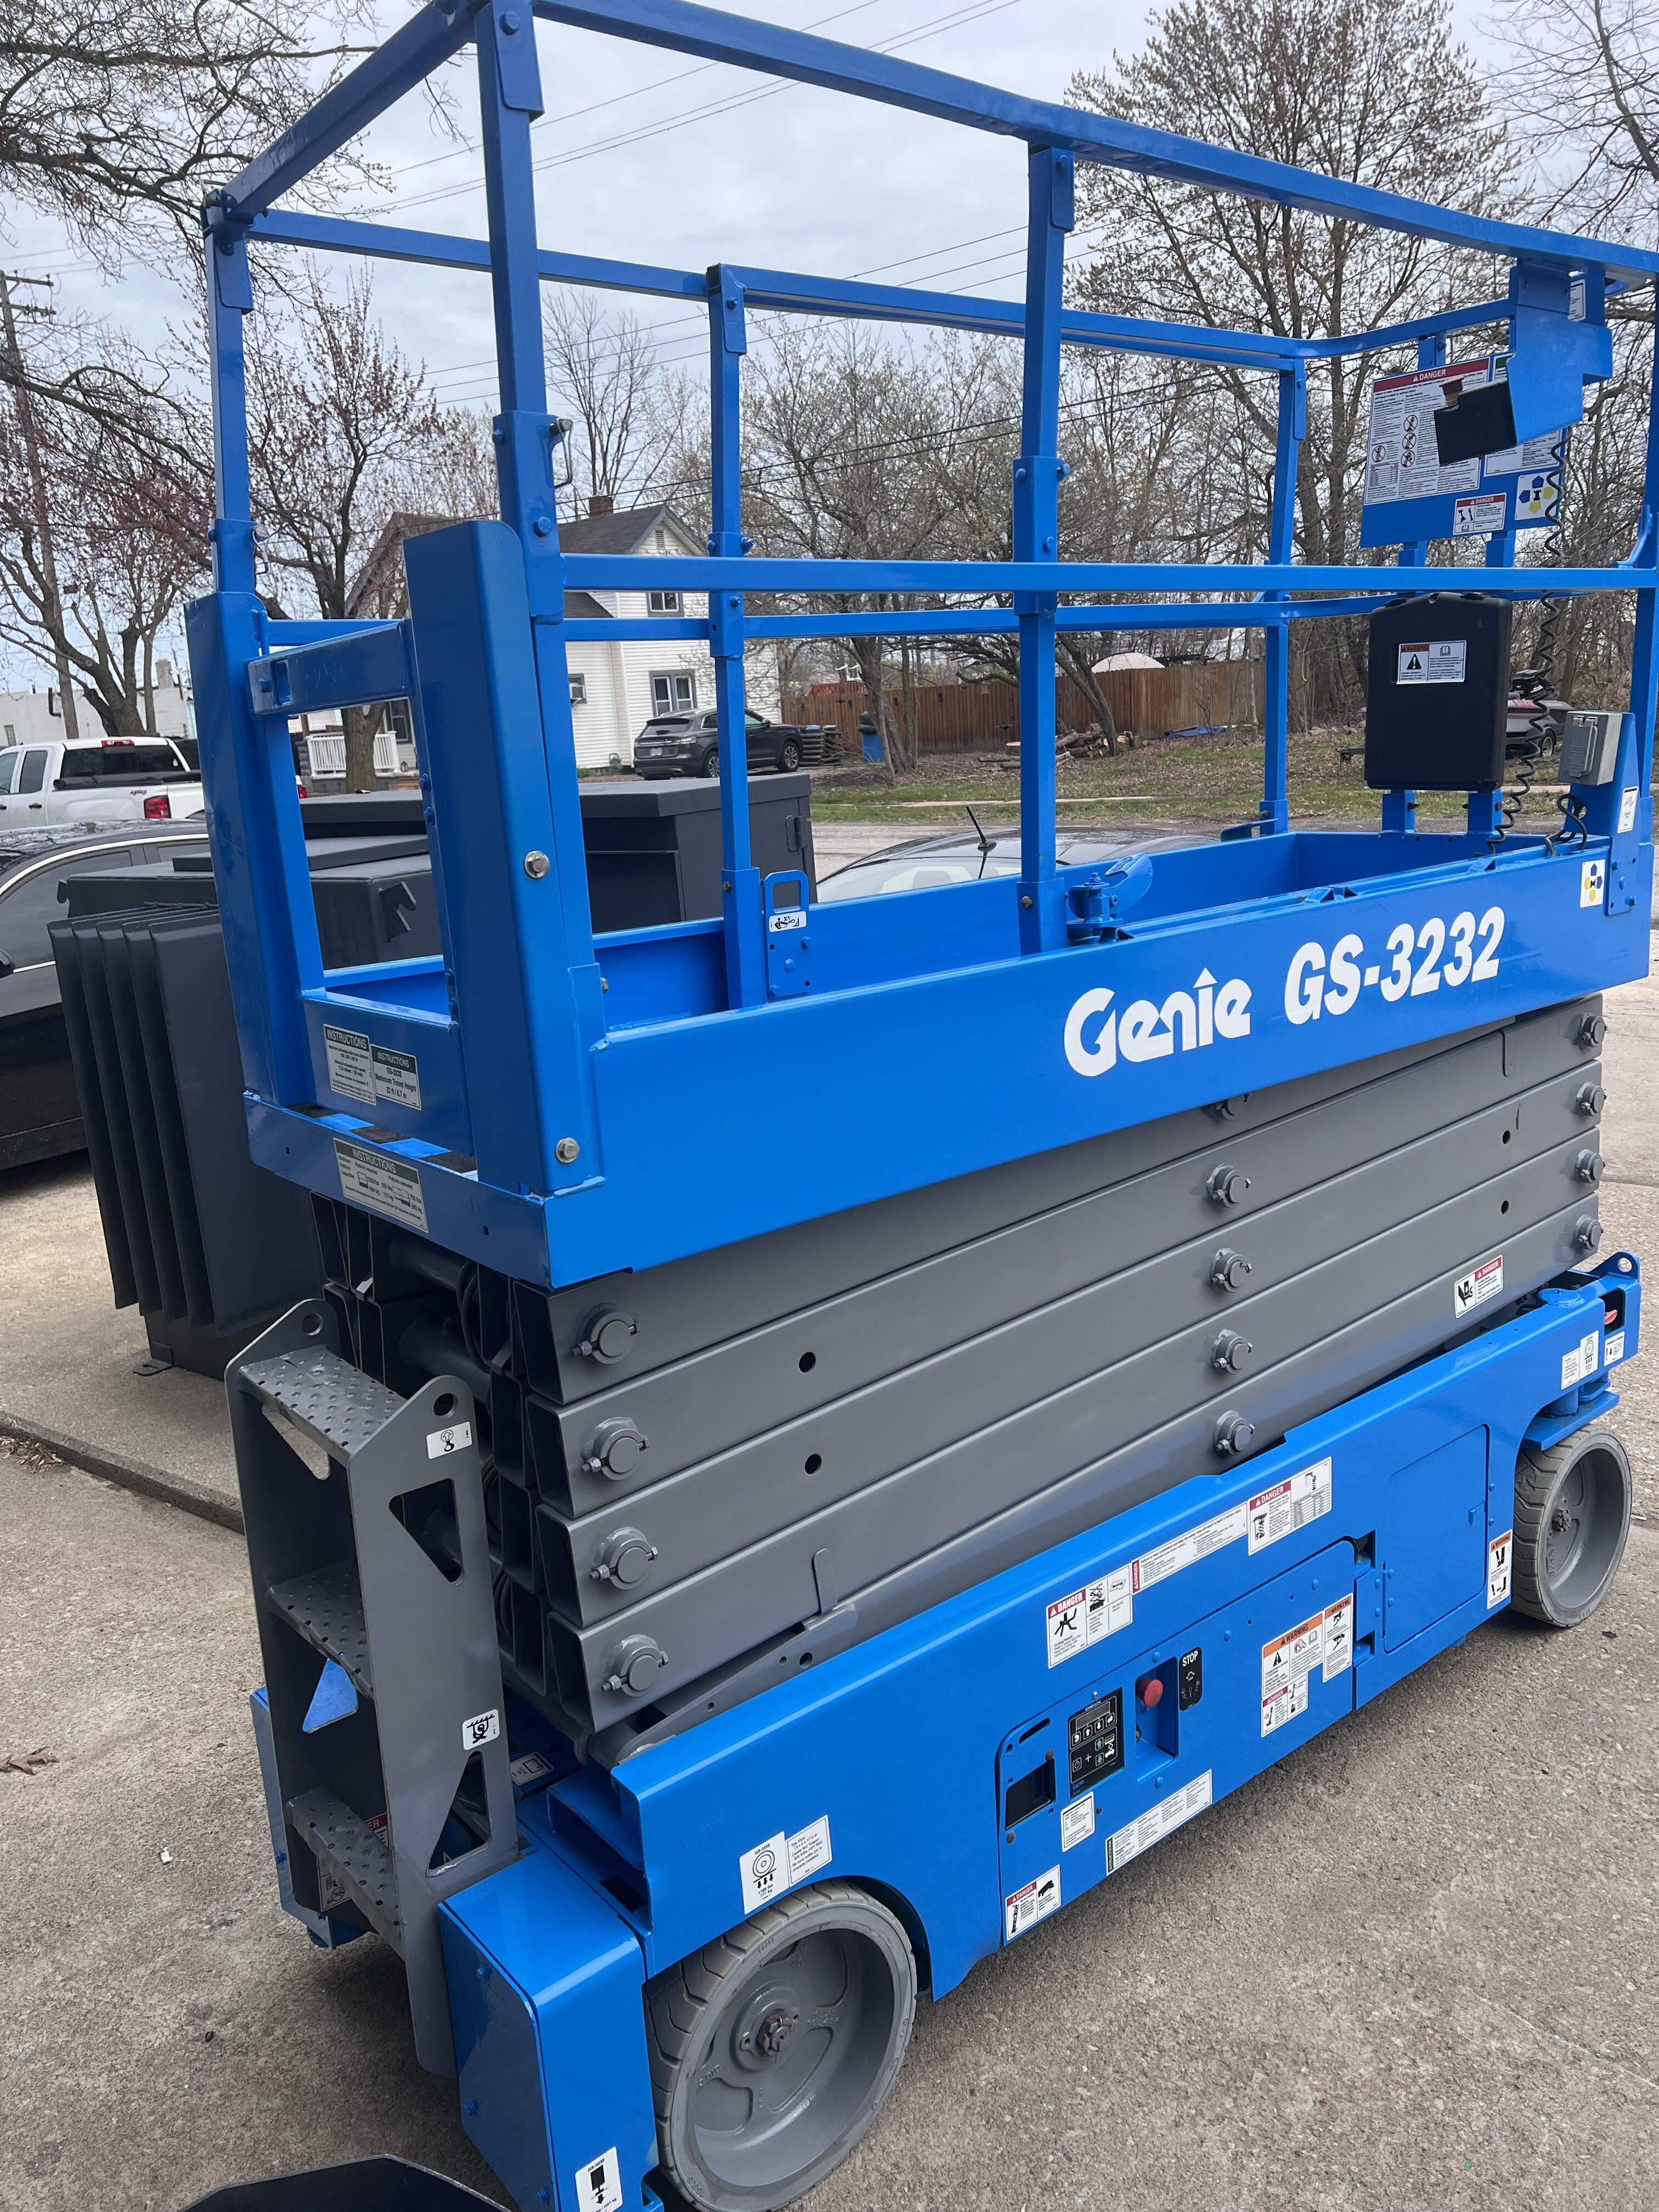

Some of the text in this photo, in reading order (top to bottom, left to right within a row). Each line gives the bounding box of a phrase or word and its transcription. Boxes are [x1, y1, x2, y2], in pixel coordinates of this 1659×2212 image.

[1419, 369, 1446, 380] DANGER
[1064, 906, 1505, 1077] Genie GS-3232
[327, 1029, 366, 1049] INSTRUCTIONS
[377, 1051, 409, 1068] INSTRUCTIONS
[375, 1073, 417, 1092] Maximum Travel Height
[352, 1148, 397, 1173] INSTRUCTIONS
[1482, 1260, 1499, 1275] DANGER
[1261, 1486, 1284, 1504] DANGER
[1058, 1593, 1082, 1611] DANGER
[1331, 1599, 1350, 1614] WARNING
[1286, 1624, 1308, 1642] WARNING
[1182, 1650, 1198, 1667] STOP
[1271, 1690, 1284, 1701] DANGER
[1017, 1885, 1033, 1898] DANGER
